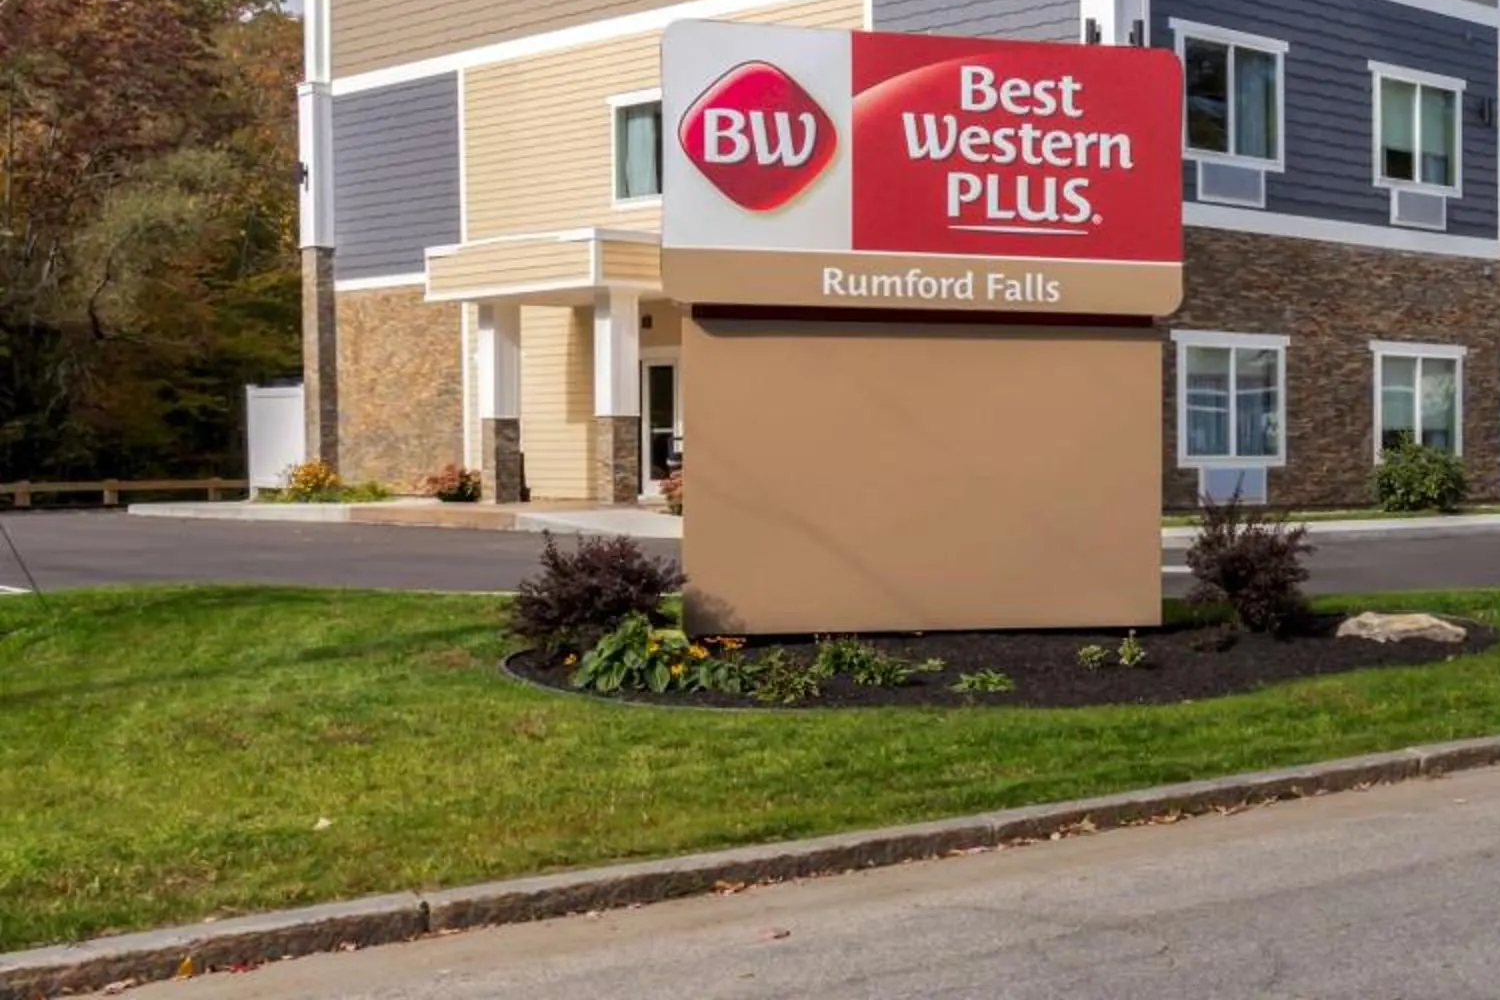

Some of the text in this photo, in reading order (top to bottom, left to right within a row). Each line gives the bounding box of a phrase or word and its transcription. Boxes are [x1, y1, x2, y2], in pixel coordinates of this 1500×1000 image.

[959, 65, 1084, 118] Best
[703, 107, 818, 168] BW
[902, 111, 1134, 169] Western
[947, 171, 1092, 224] PLUS
[822, 266, 1061, 304] Rumford Falls
